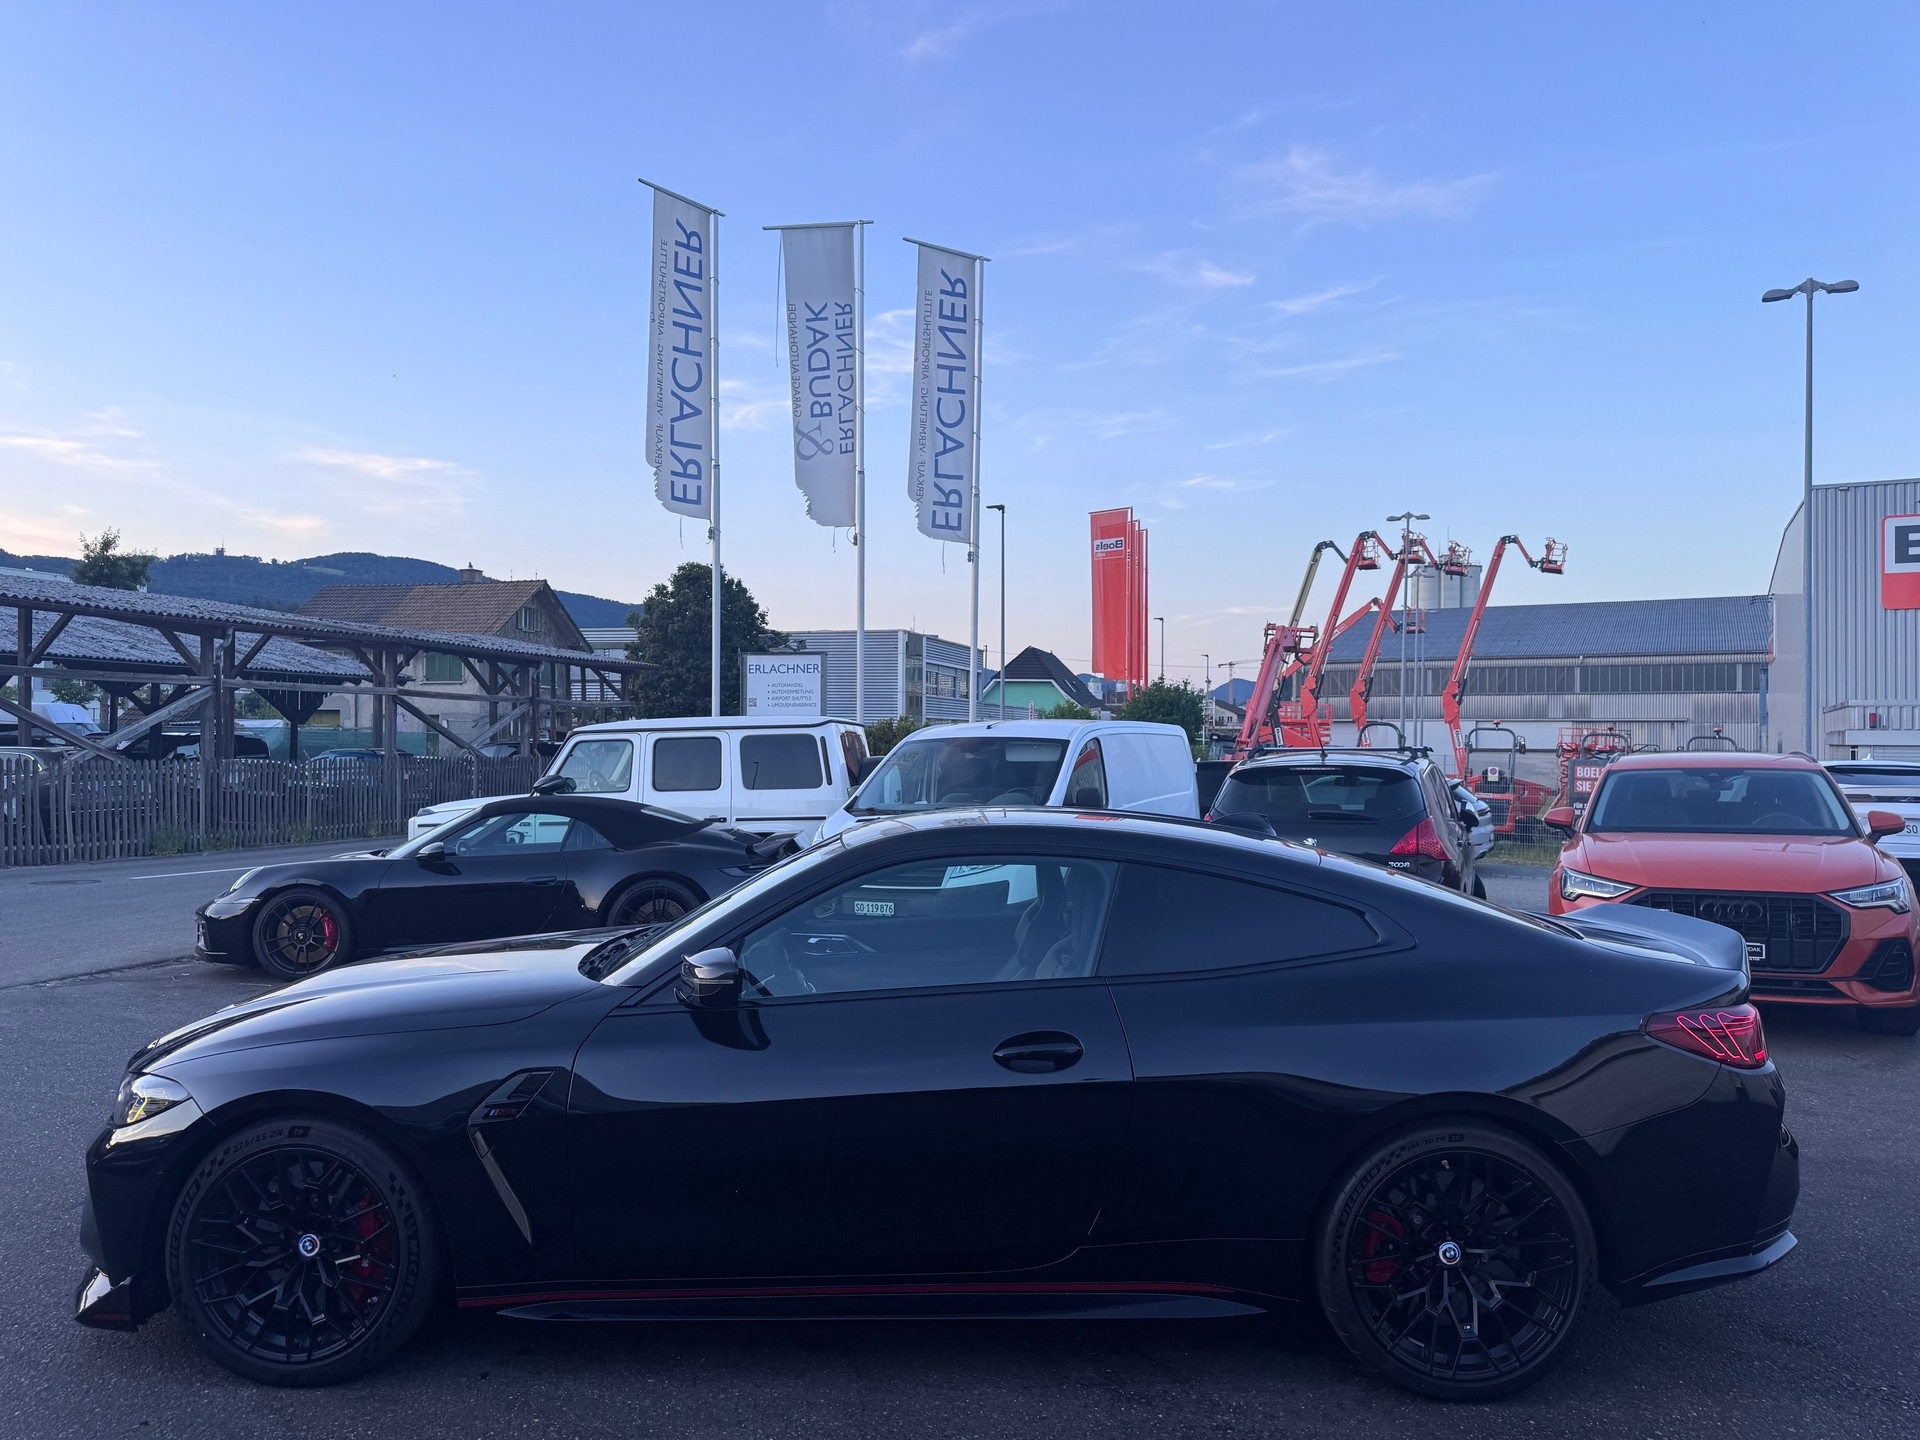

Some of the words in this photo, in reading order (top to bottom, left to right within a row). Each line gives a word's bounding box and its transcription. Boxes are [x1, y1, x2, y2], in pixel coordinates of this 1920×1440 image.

[748, 663, 820, 674] ERLACHNER
[1576, 766, 1604, 778] BOEL
[1576, 781, 1591, 792] SIE
[1905, 824, 1918, 834] SO
